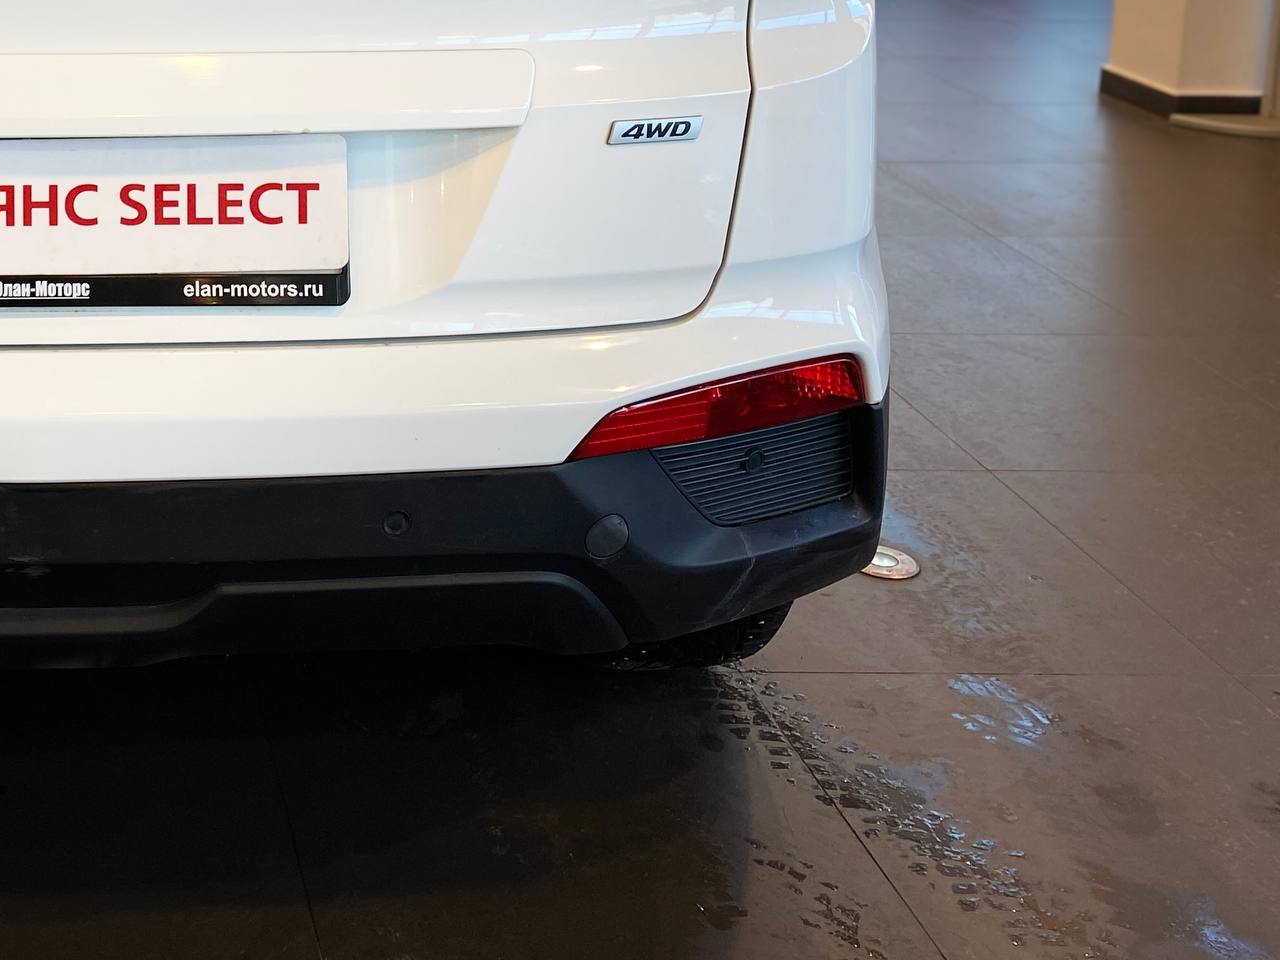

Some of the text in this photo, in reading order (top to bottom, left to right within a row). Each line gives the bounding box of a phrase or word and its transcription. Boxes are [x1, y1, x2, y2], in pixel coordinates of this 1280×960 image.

[621, 120, 692, 140] 4WD
[119, 183, 320, 226] SELECT
[183, 280, 324, 297] elan-motors.ru
